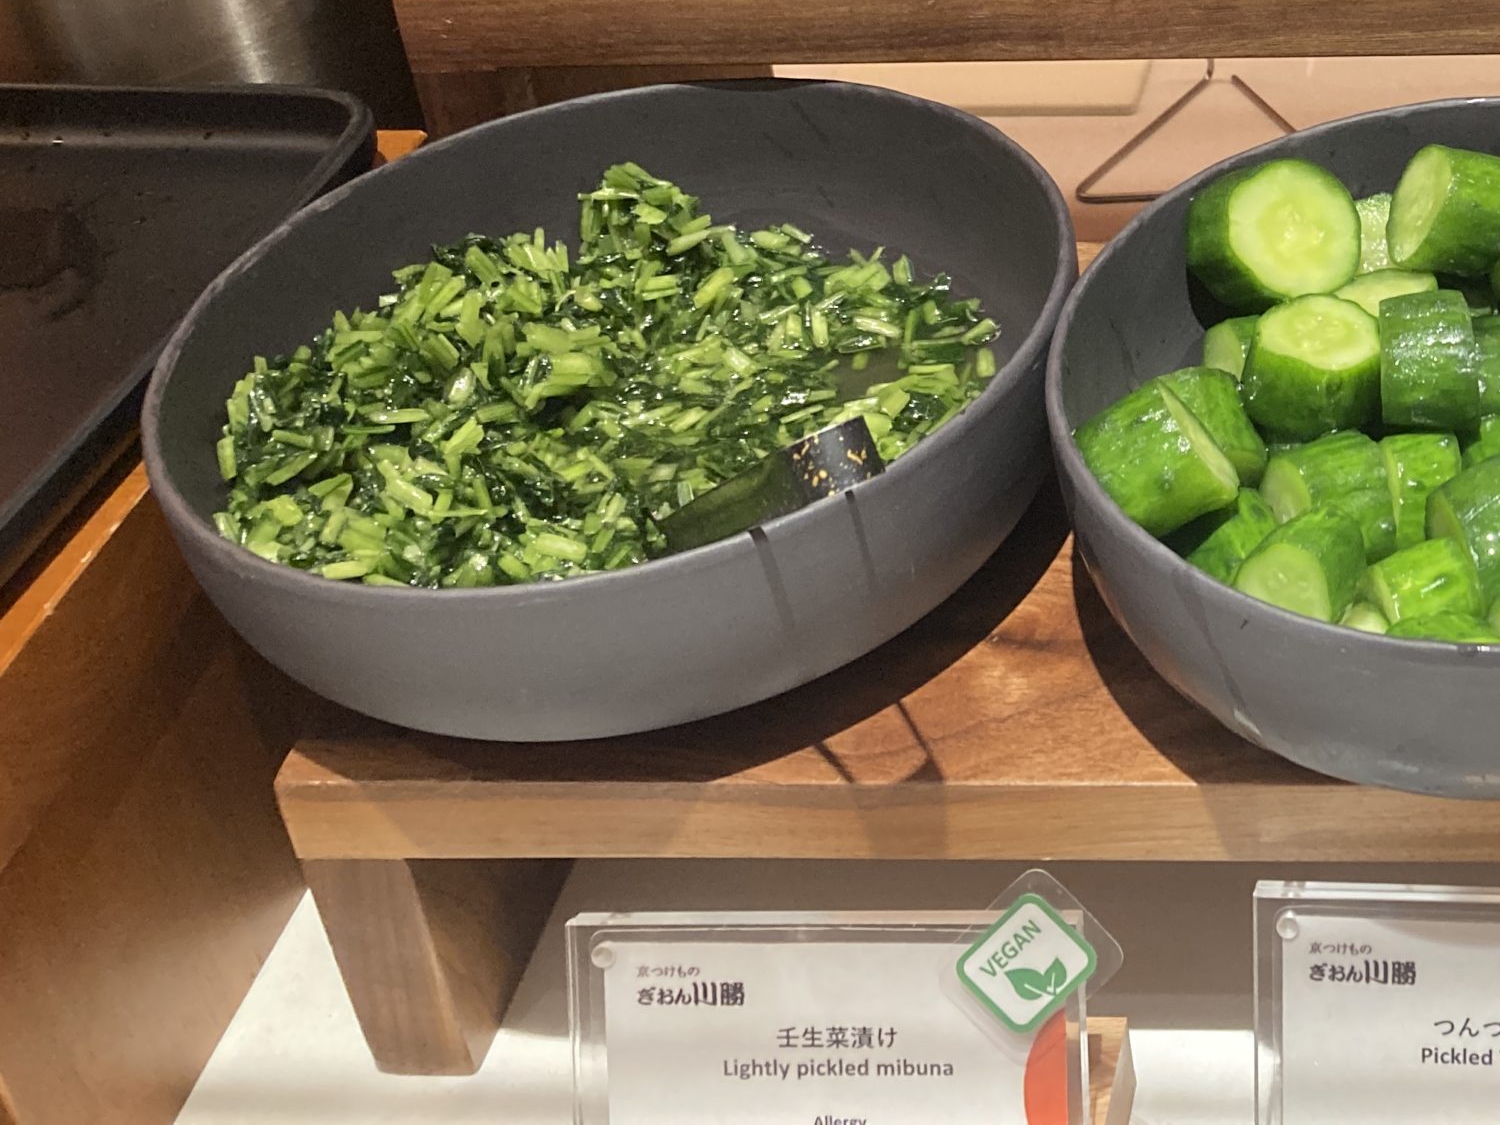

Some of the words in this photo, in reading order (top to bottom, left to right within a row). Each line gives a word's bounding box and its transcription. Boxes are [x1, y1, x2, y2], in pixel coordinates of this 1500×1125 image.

[979, 919, 1042, 978] VEGAN
[1308, 941, 1373, 956] 京つけもの
[1309, 959, 1417, 986] ぎおん川勝
[637, 981, 745, 1007] ぎおん川勝
[776, 1026, 898, 1050] 壬生菜漬け
[1421, 1047, 1493, 1066] Pickled
[723, 1058, 790, 1081] Lightly
[796, 1058, 869, 1080] pickled
[876, 1058, 954, 1076] mibuna
